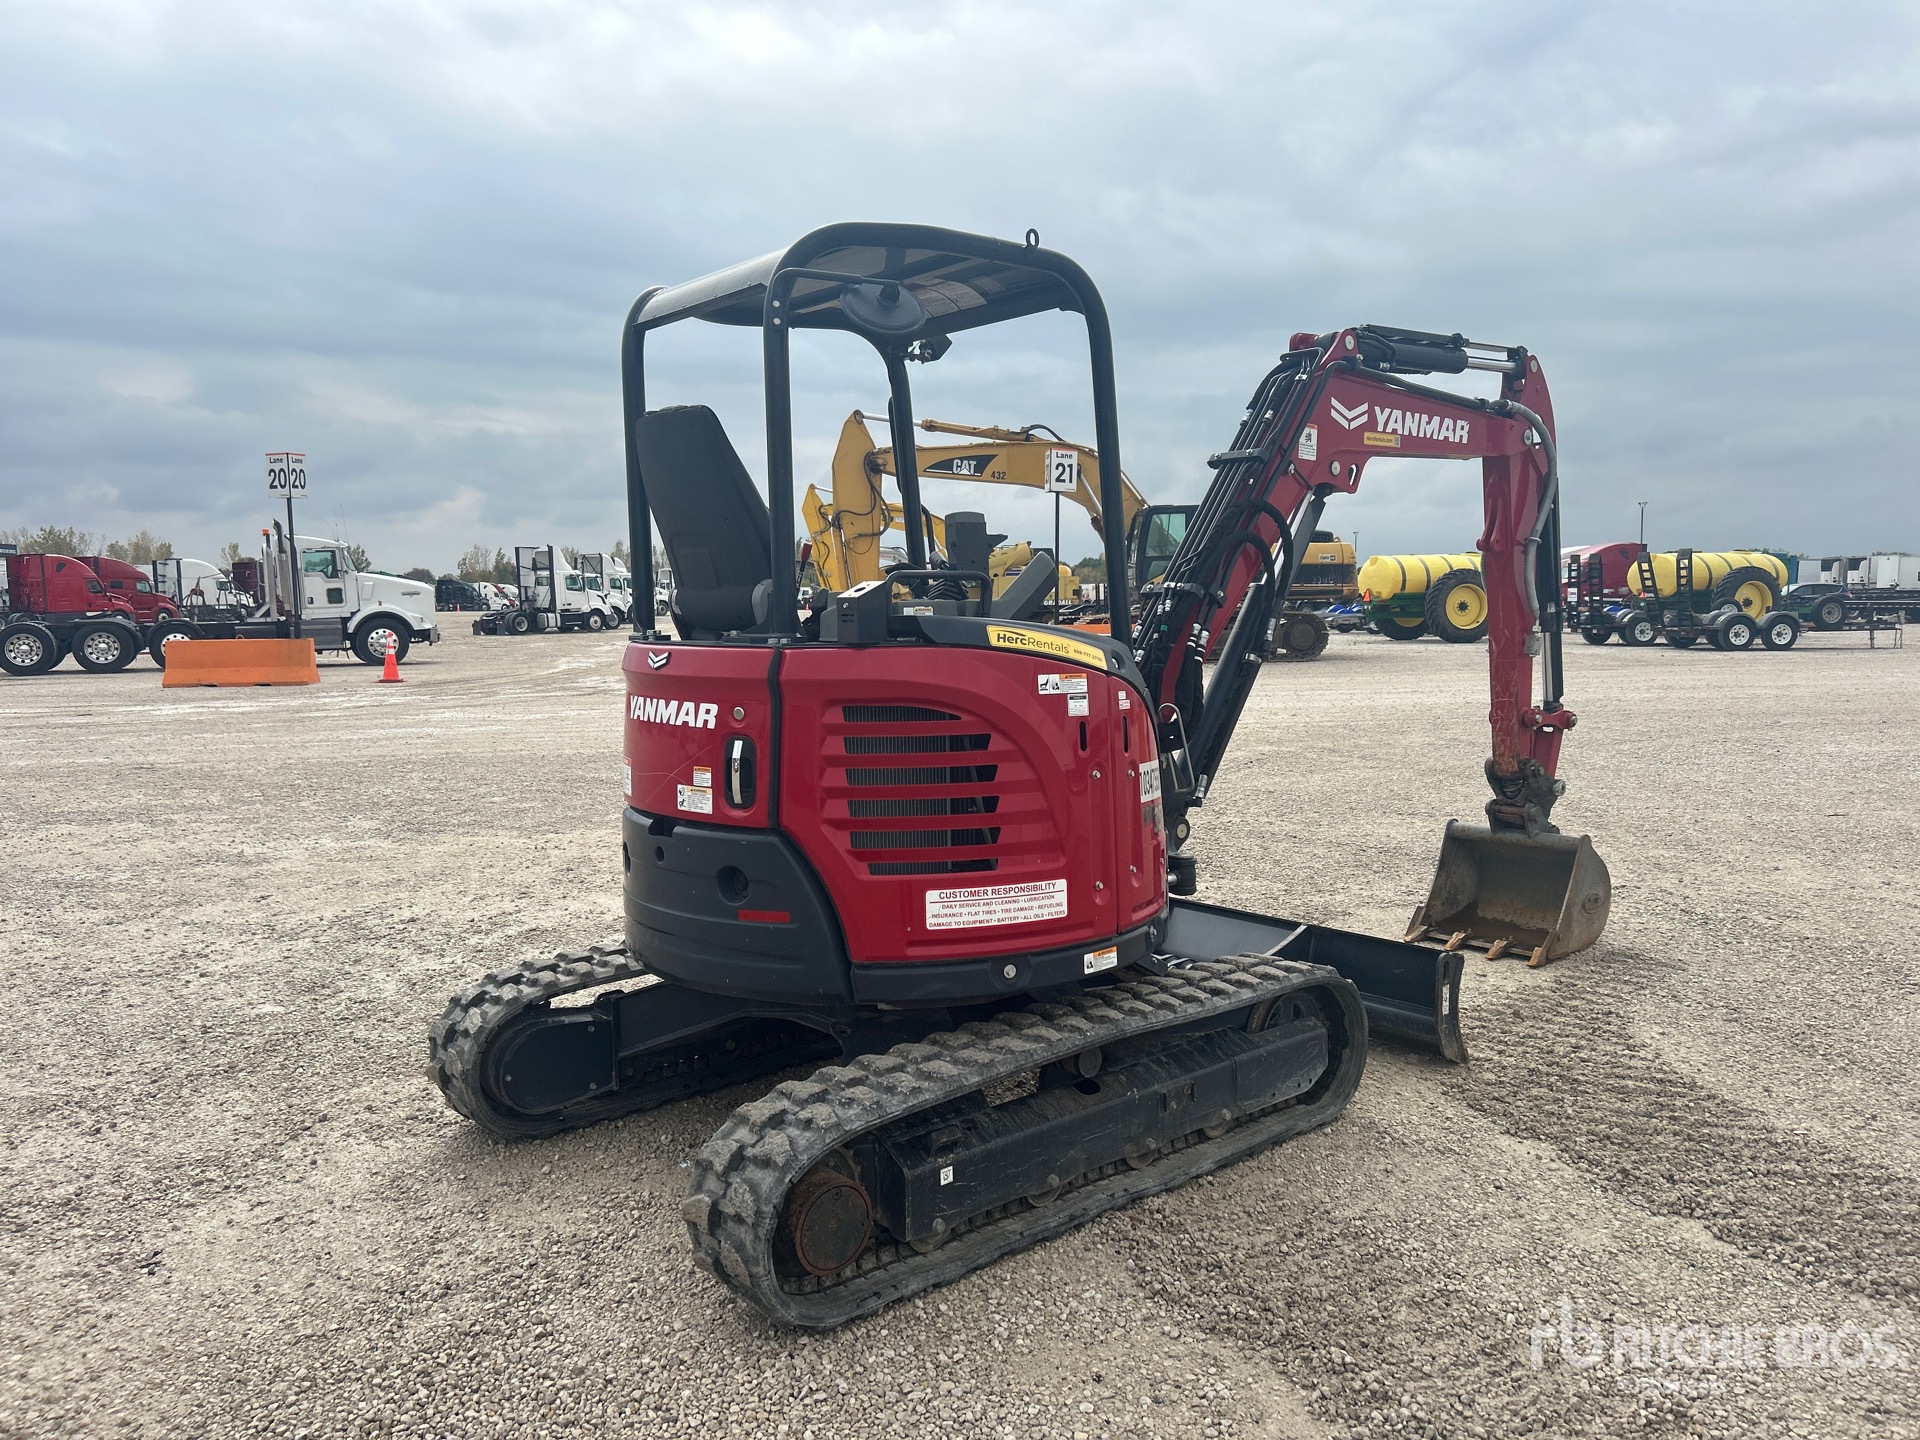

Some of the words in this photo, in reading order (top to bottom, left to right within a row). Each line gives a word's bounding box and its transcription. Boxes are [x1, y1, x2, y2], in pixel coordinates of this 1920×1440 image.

[1374, 405, 1470, 444] YANMAR
[269, 456, 284, 464] Lane
[1055, 451, 1073, 460] Lane
[952, 458, 977, 475] CAT
[990, 470, 1007, 480] 432
[1055, 462, 1074, 484] 21
[268, 467, 288, 490] 20
[290, 467, 307, 490] 20
[996, 632, 1071, 655] HercRentals
[630, 694, 718, 730] YANMAR
[938, 889, 989, 900] CUSTOMER
[991, 881, 1057, 897] RESPONSIBILITY
[931, 911, 964, 919] INSURANCE
[981, 908, 997, 916] TIRES
[1012, 904, 1035, 913] DAMAGE
[1037, 901, 1064, 910] REFUELING
[958, 901, 982, 909] SERVICE
[994, 898, 1021, 906] CLEANING
[1023, 894, 1055, 903] LUBRICATION
[928, 920, 953, 928] DAMAGE
[962, 917, 994, 926] EQUIPMENT
[996, 915, 1020, 923] BATTERY
[1047, 909, 1066, 917] FILTERS
